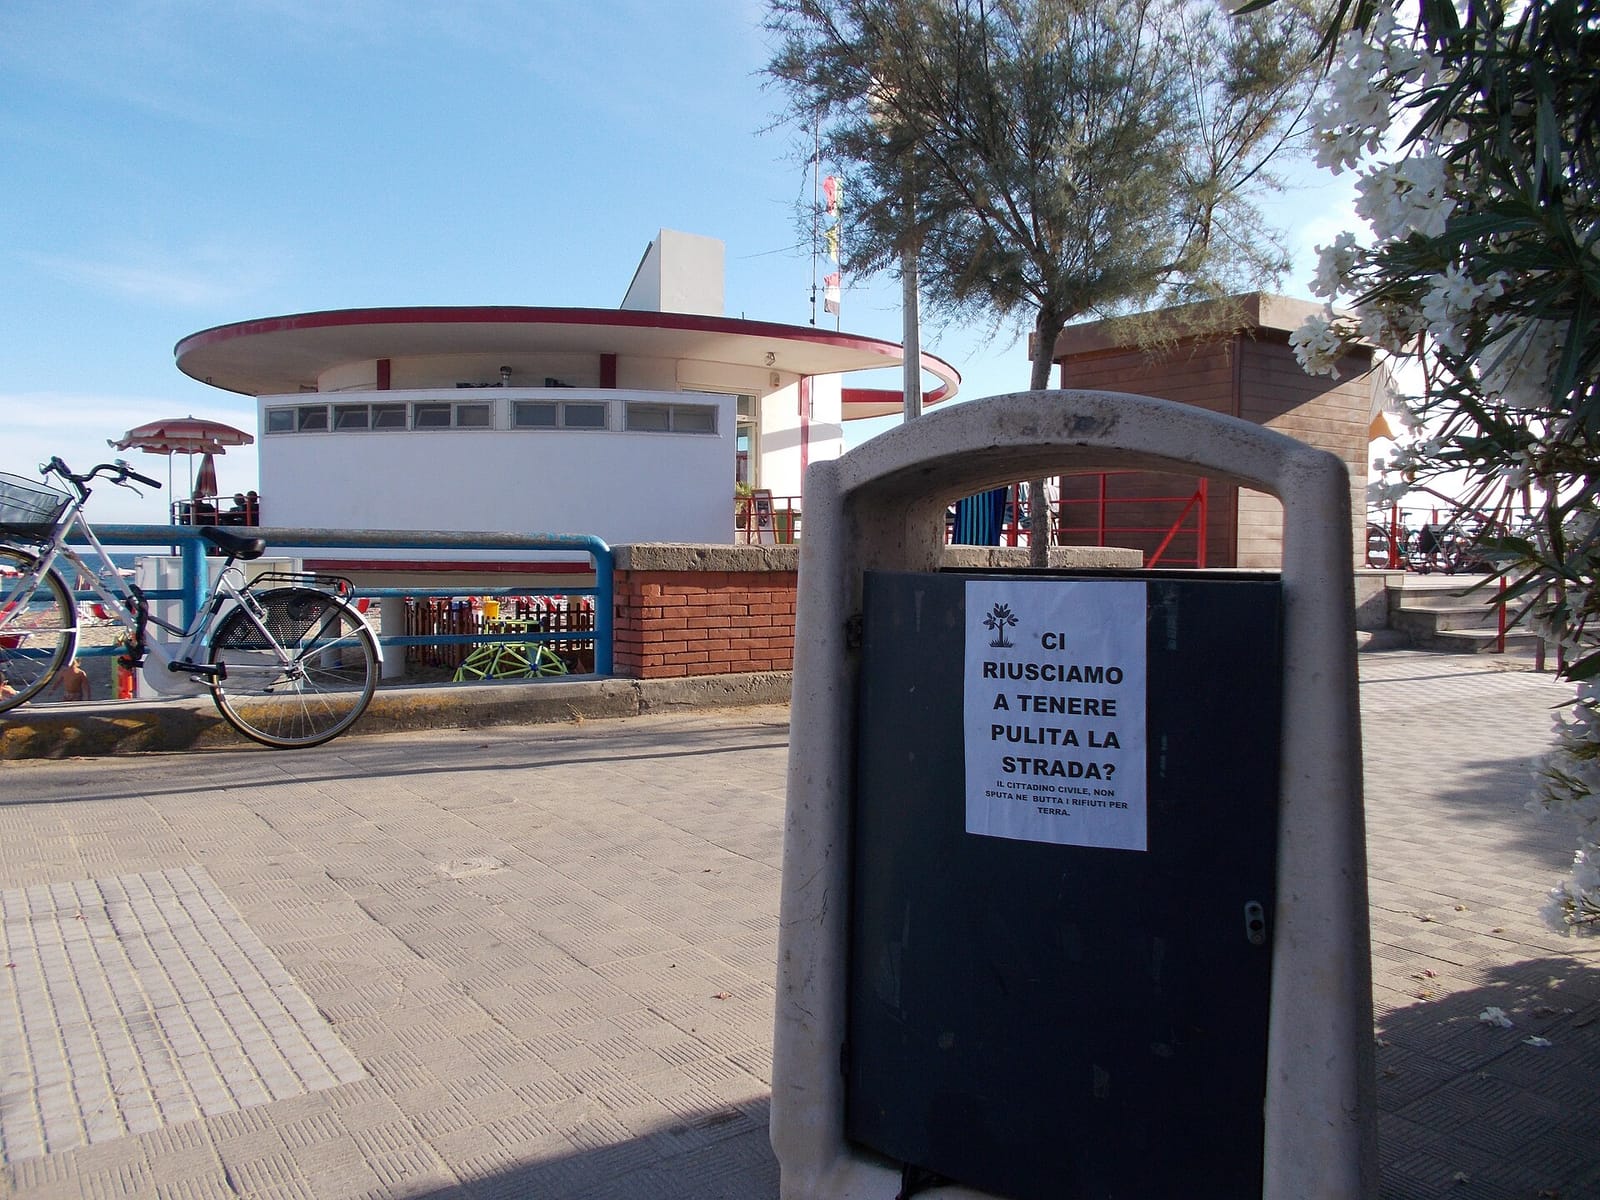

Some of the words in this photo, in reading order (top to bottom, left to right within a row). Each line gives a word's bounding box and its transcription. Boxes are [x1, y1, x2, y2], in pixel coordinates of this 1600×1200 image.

[1041, 632, 1066, 650] CI
[983, 661, 1124, 685] RIUSCIAMO
[993, 693, 1010, 711] A
[1016, 694, 1117, 717] TENERE
[991, 724, 1080, 747] PULITA
[1087, 730, 1121, 749] LA
[1001, 755, 1116, 780] STRADA?
[996, 780, 1005, 788] IL
[1007, 781, 1056, 792] CITTADINO
[1057, 785, 1092, 796] CIVILE,
[1093, 788, 1115, 797] NON
[985, 790, 1014, 800] SPUTA
[1015, 793, 1029, 802] NE
[1032, 794, 1064, 805] BUTTA
[1066, 797, 1069, 805] I
[1071, 797, 1107, 808] RIFIUTI
[1108, 800, 1129, 810] PER
[1037, 806, 1071, 817] TERRA.
